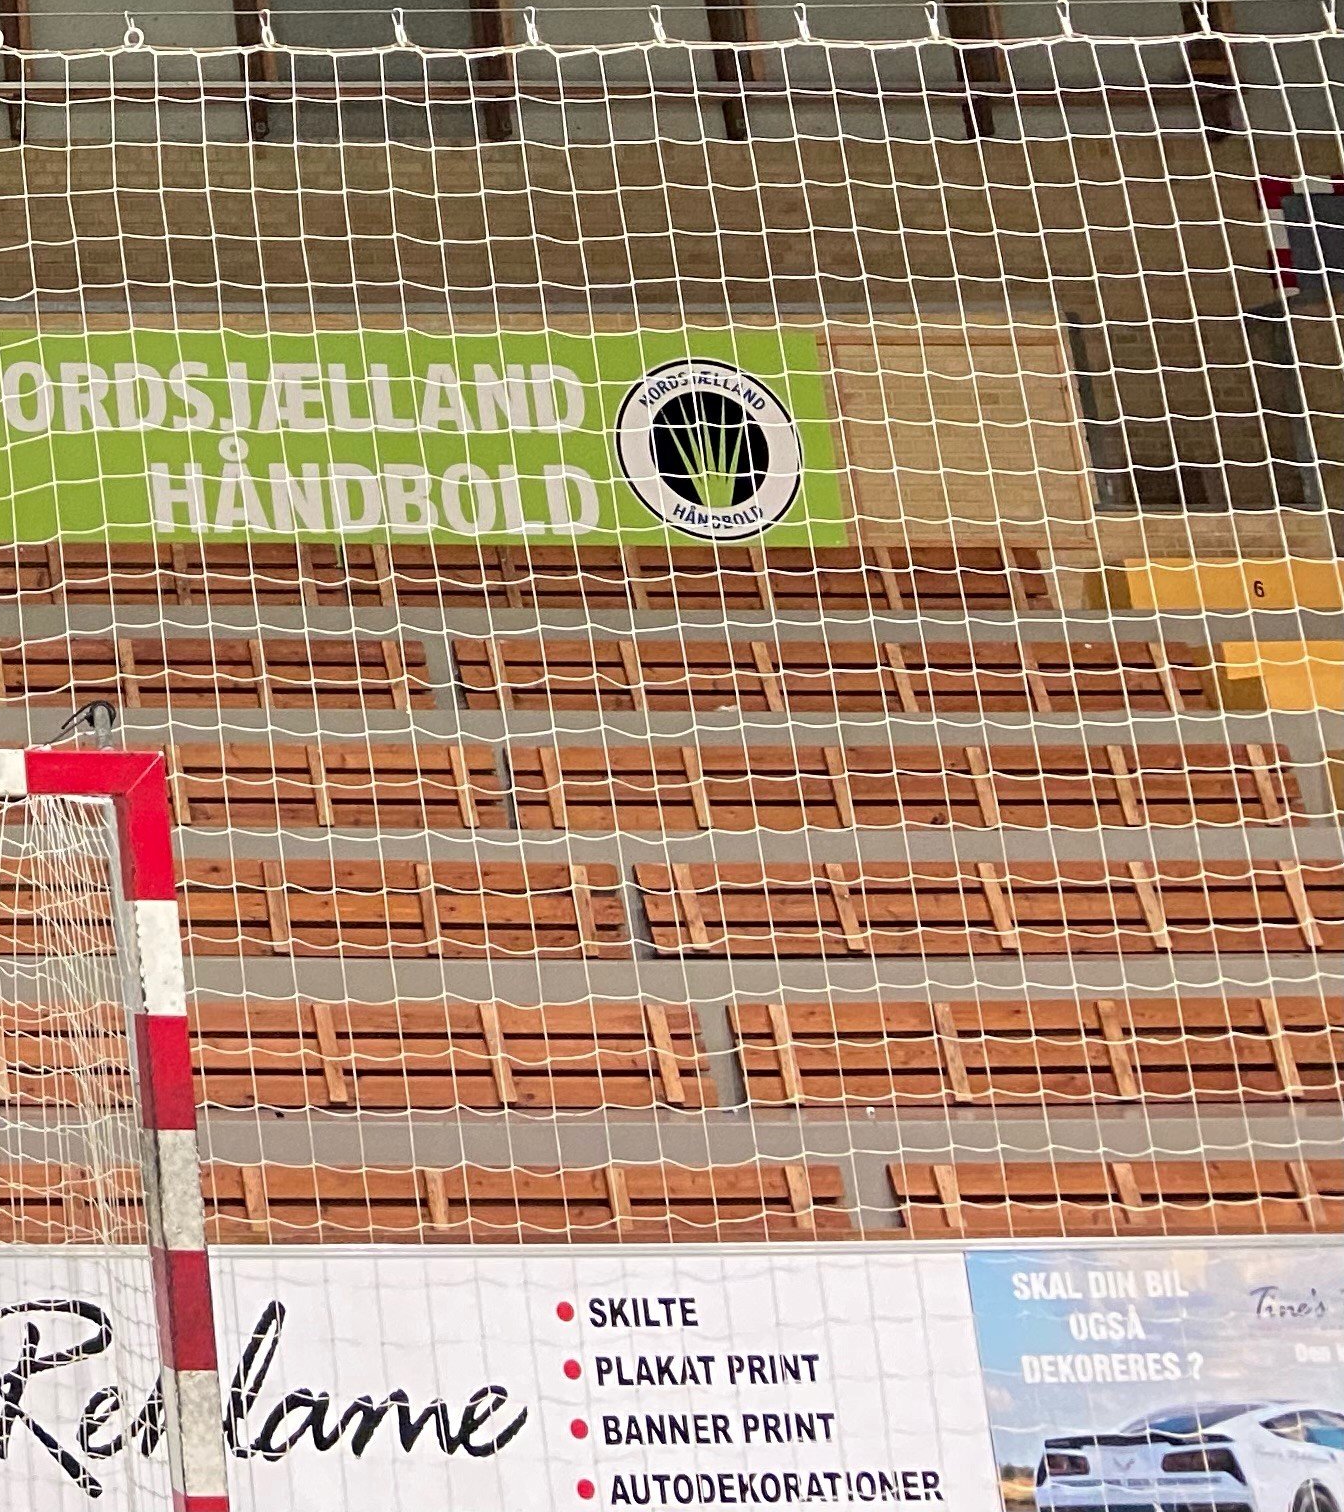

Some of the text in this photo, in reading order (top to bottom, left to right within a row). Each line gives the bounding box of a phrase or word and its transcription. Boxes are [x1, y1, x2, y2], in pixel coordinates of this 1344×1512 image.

[638, 370, 766, 411] NORDSJÆLLAND
[150, 437, 601, 537] HÅNDBOLD
[672, 502, 765, 530] HÅNDBOLD
[1253, 580, 1265, 598] 6
[1012, 1268, 1190, 1301] SKAL DIN BIL
[588, 1297, 699, 1328] SKILTE
[1069, 1304, 1147, 1341] OGSÅ
[595, 1353, 820, 1387] PLAKAT PRINT
[1020, 1352, 1182, 1384] DEKORERES
[602, 1412, 836, 1446] BANNER PRINT
[610, 1470, 947, 1506] AUTODEKORATIONER
